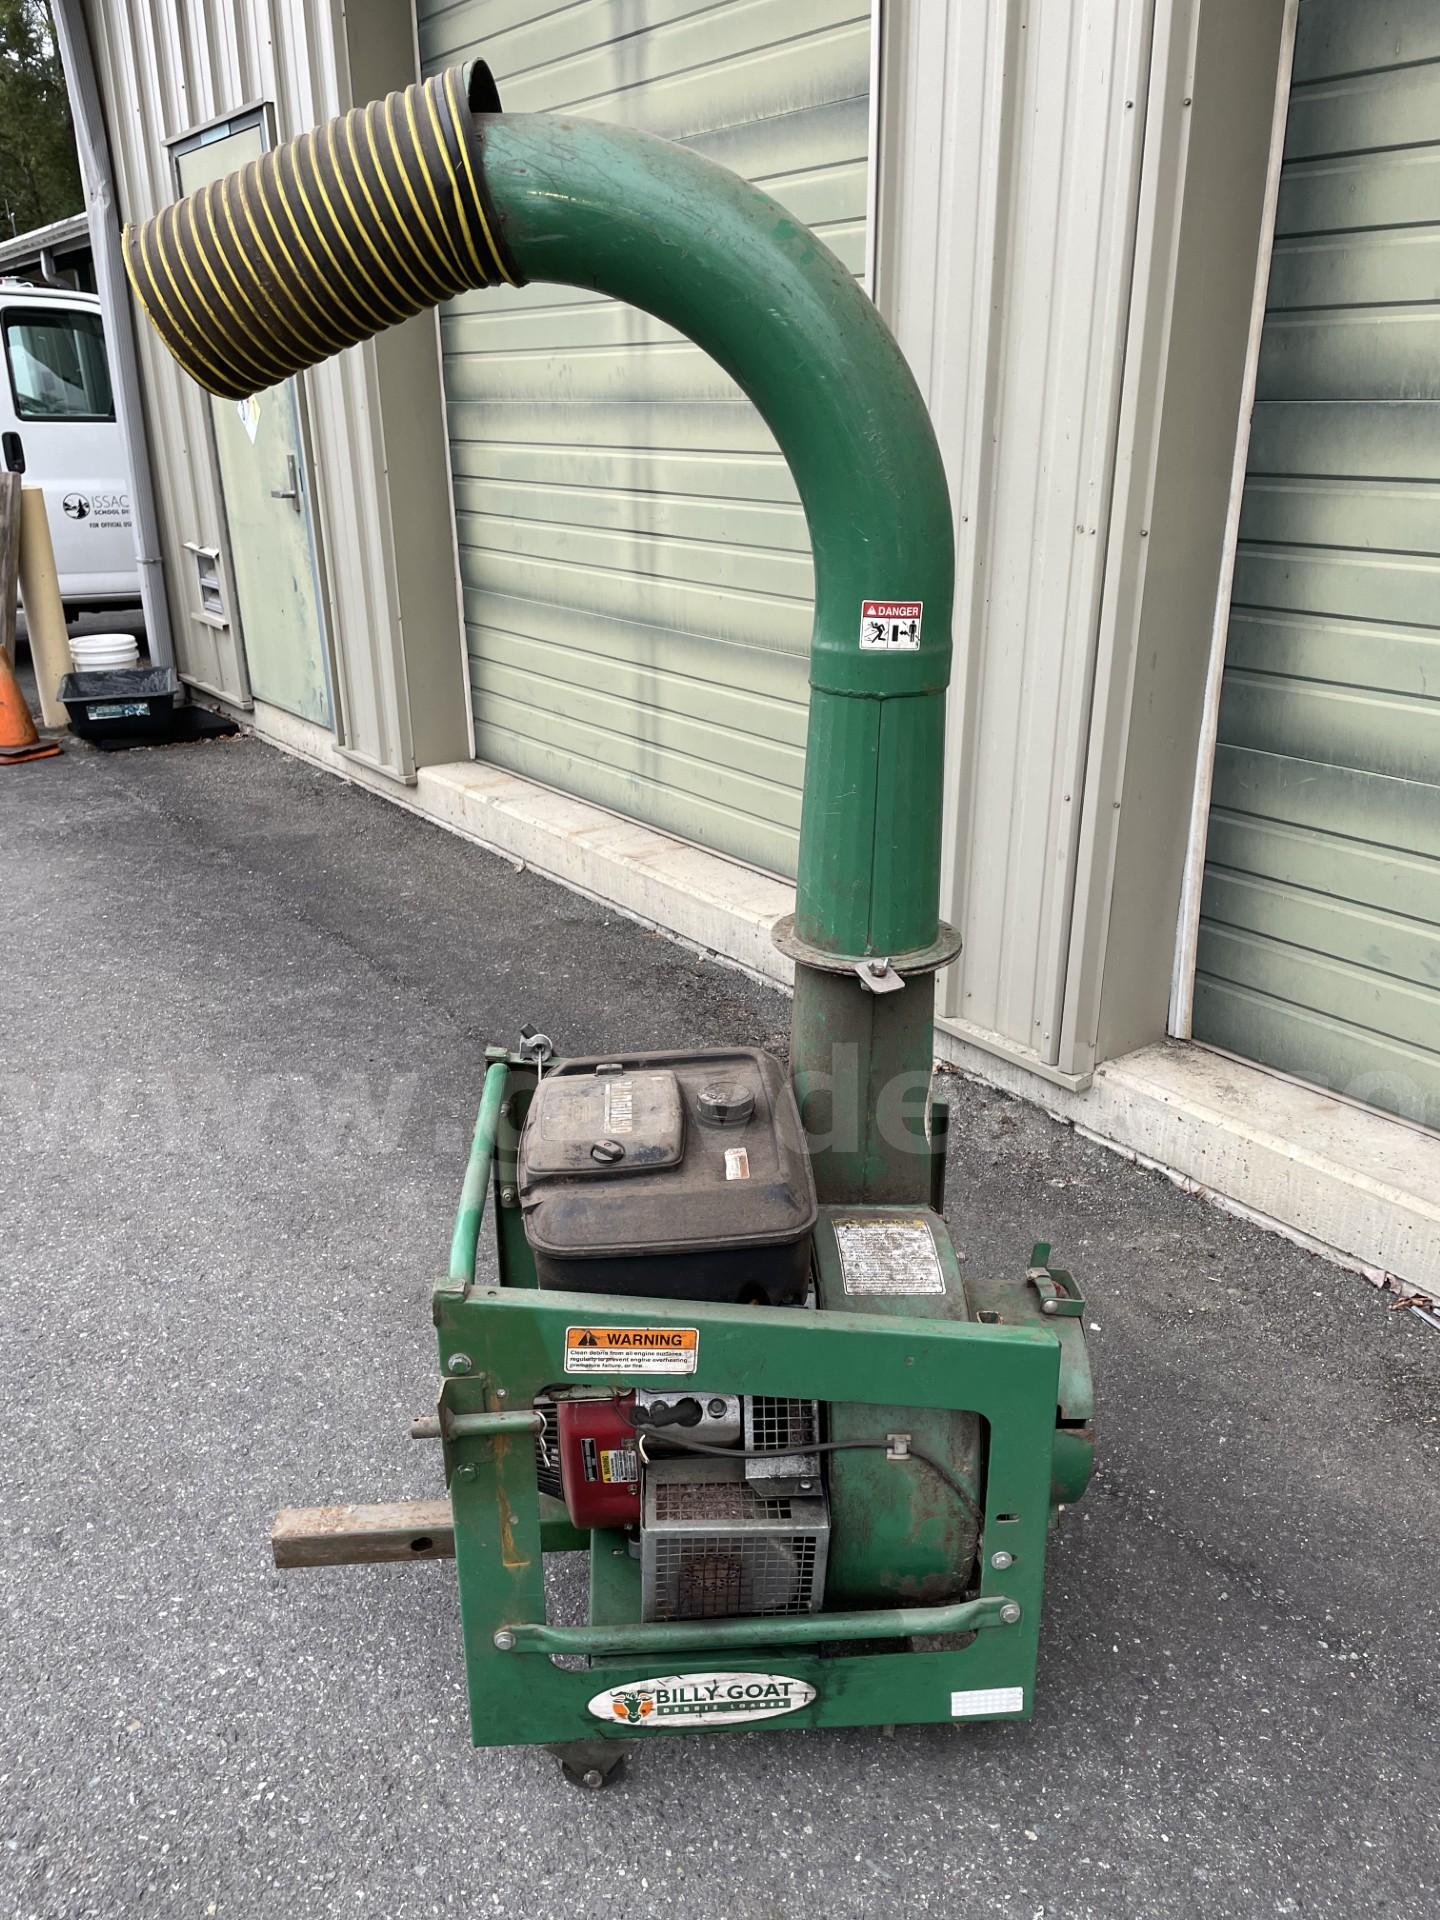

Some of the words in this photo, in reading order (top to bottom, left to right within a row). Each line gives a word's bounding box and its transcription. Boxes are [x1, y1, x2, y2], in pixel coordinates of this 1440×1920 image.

[878, 606, 919, 616] DANGER
[607, 1333, 682, 1346] WARNING
[656, 1685, 720, 1704] BILLY
[727, 1682, 794, 1699] GOAT
